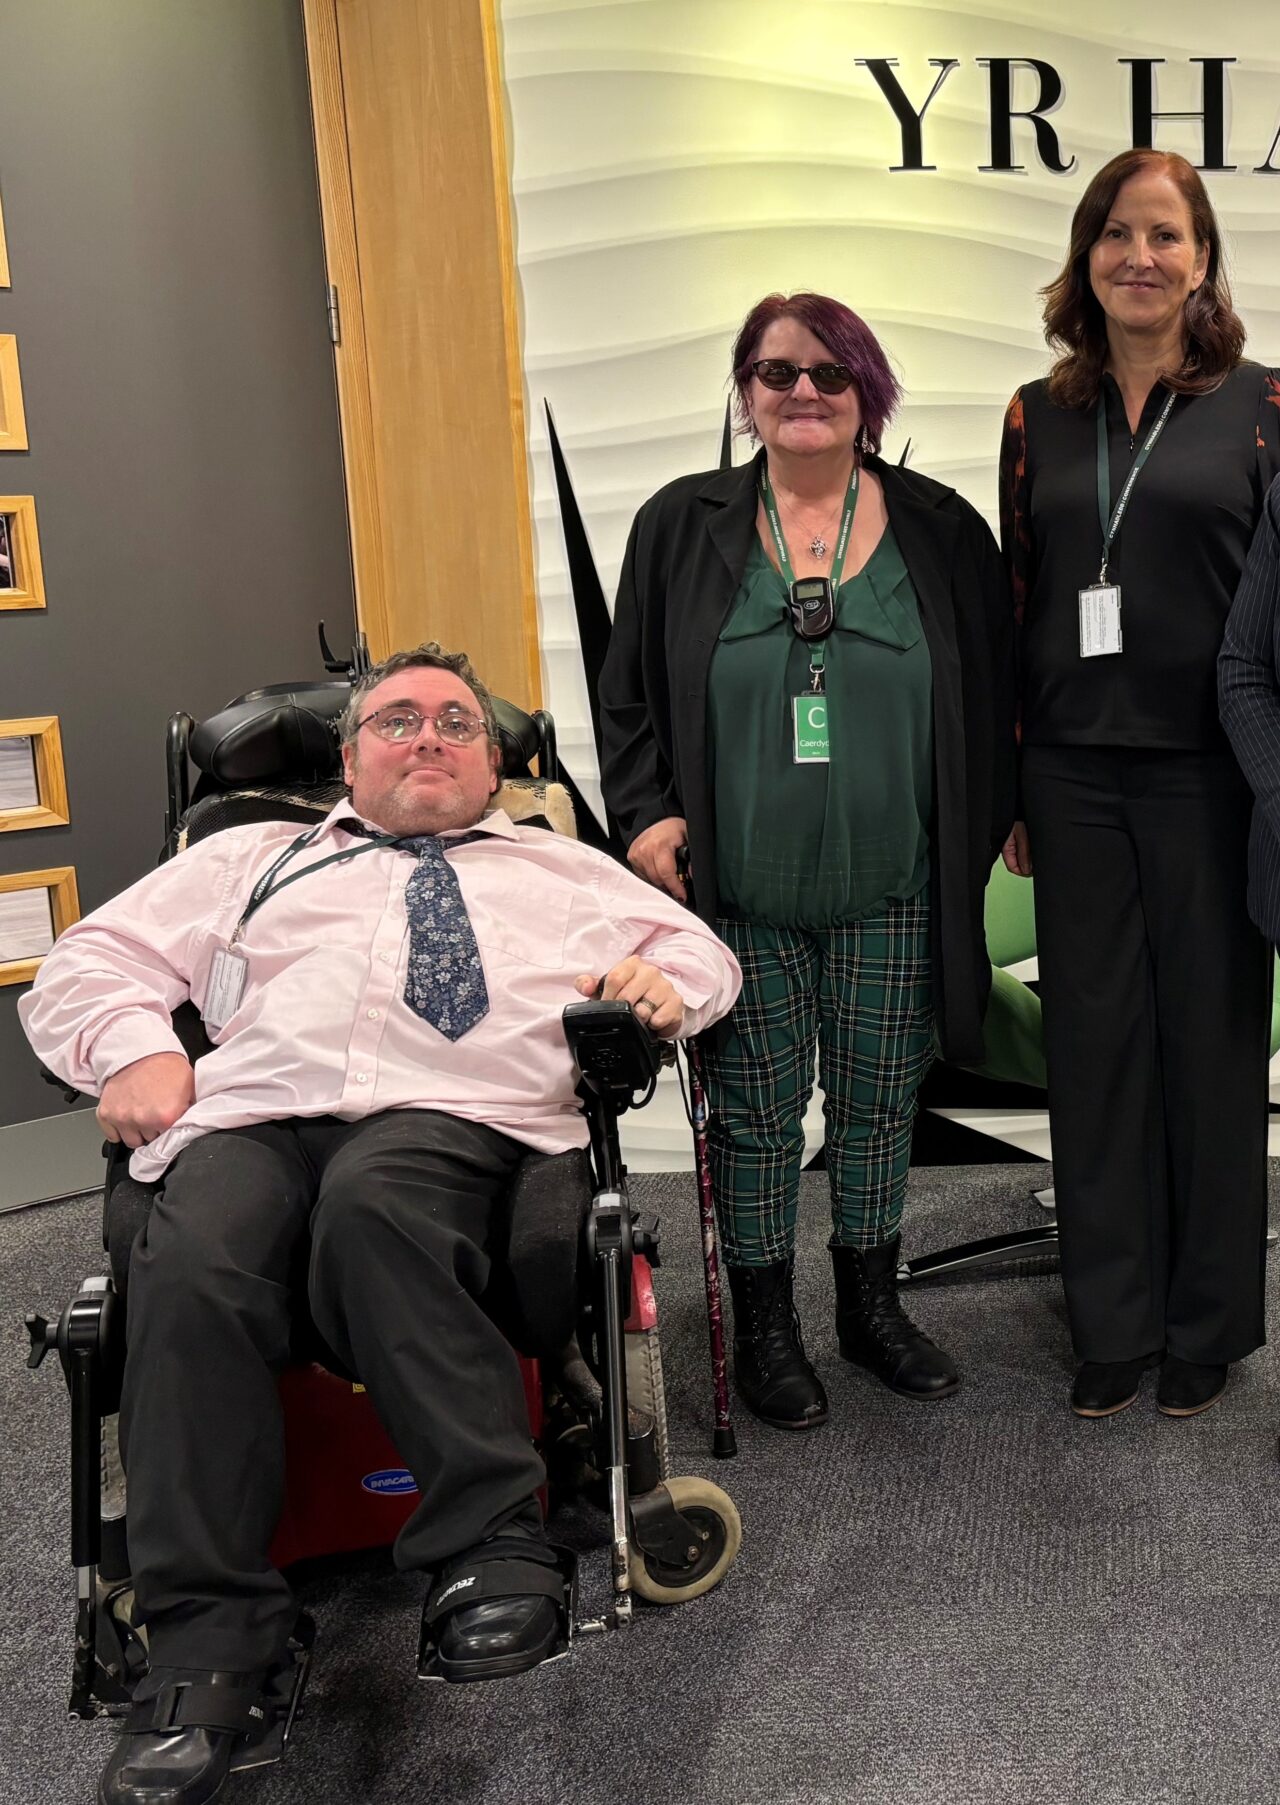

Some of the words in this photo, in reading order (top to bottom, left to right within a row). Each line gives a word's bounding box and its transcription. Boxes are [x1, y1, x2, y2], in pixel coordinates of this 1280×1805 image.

[854, 57, 1077, 174] YR
[1162, 392, 1177, 418] CONFERENC
[808, 707, 825, 728] C
[371, 1475, 415, 1488] INVACAR
